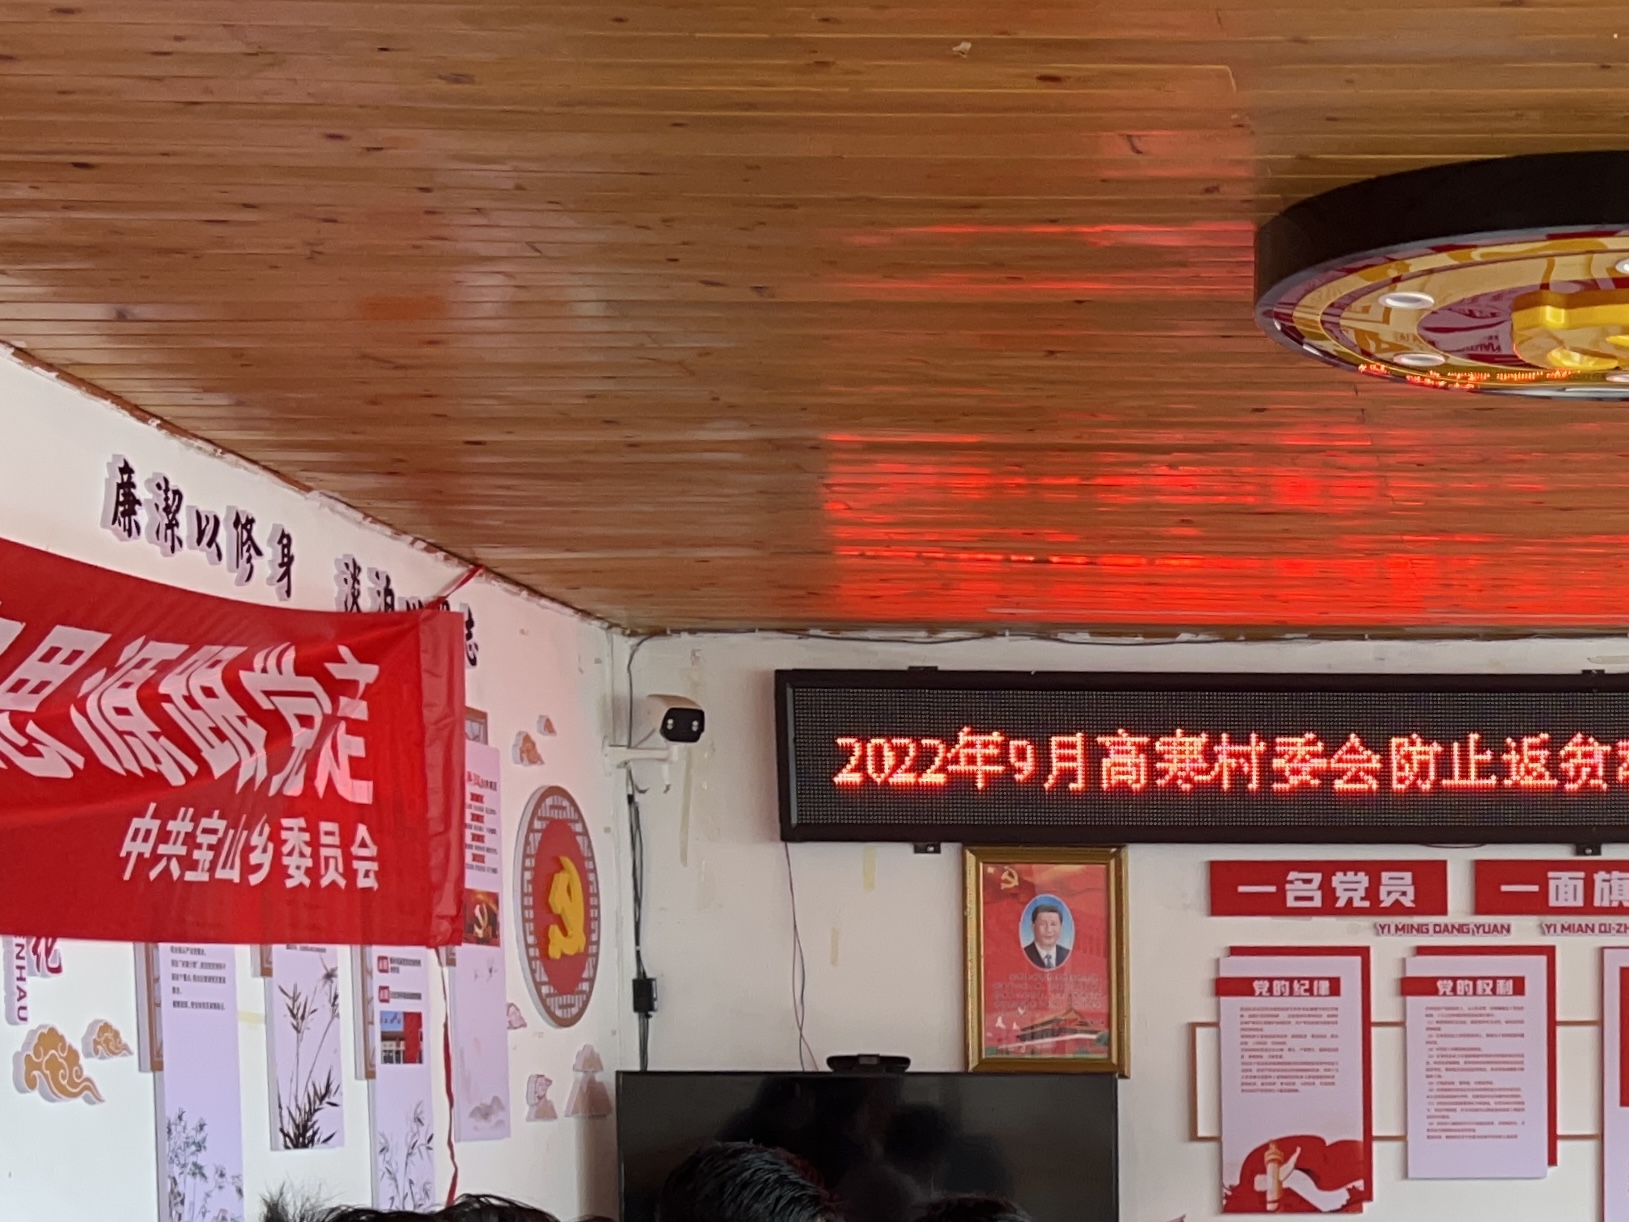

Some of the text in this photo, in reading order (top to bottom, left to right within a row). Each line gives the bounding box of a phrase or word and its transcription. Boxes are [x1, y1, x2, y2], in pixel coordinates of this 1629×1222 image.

[0, 617, 380, 805] 思源跟党走
[120, 802, 380, 890] 中共宝山乡委员会
[1237, 871, 1415, 908] 一名党员
[1379, 923, 1391, 935] YI
[1394, 923, 1430, 935] MING
[1473, 923, 1510, 935] YUAN
[1545, 923, 1557, 935] YI
[1560, 923, 1596, 935] MIAN
[14, 936, 28, 1021] NHAU
[1252, 979, 1330, 996] 党的纪律
[1436, 979, 1514, 996] 党的权利
